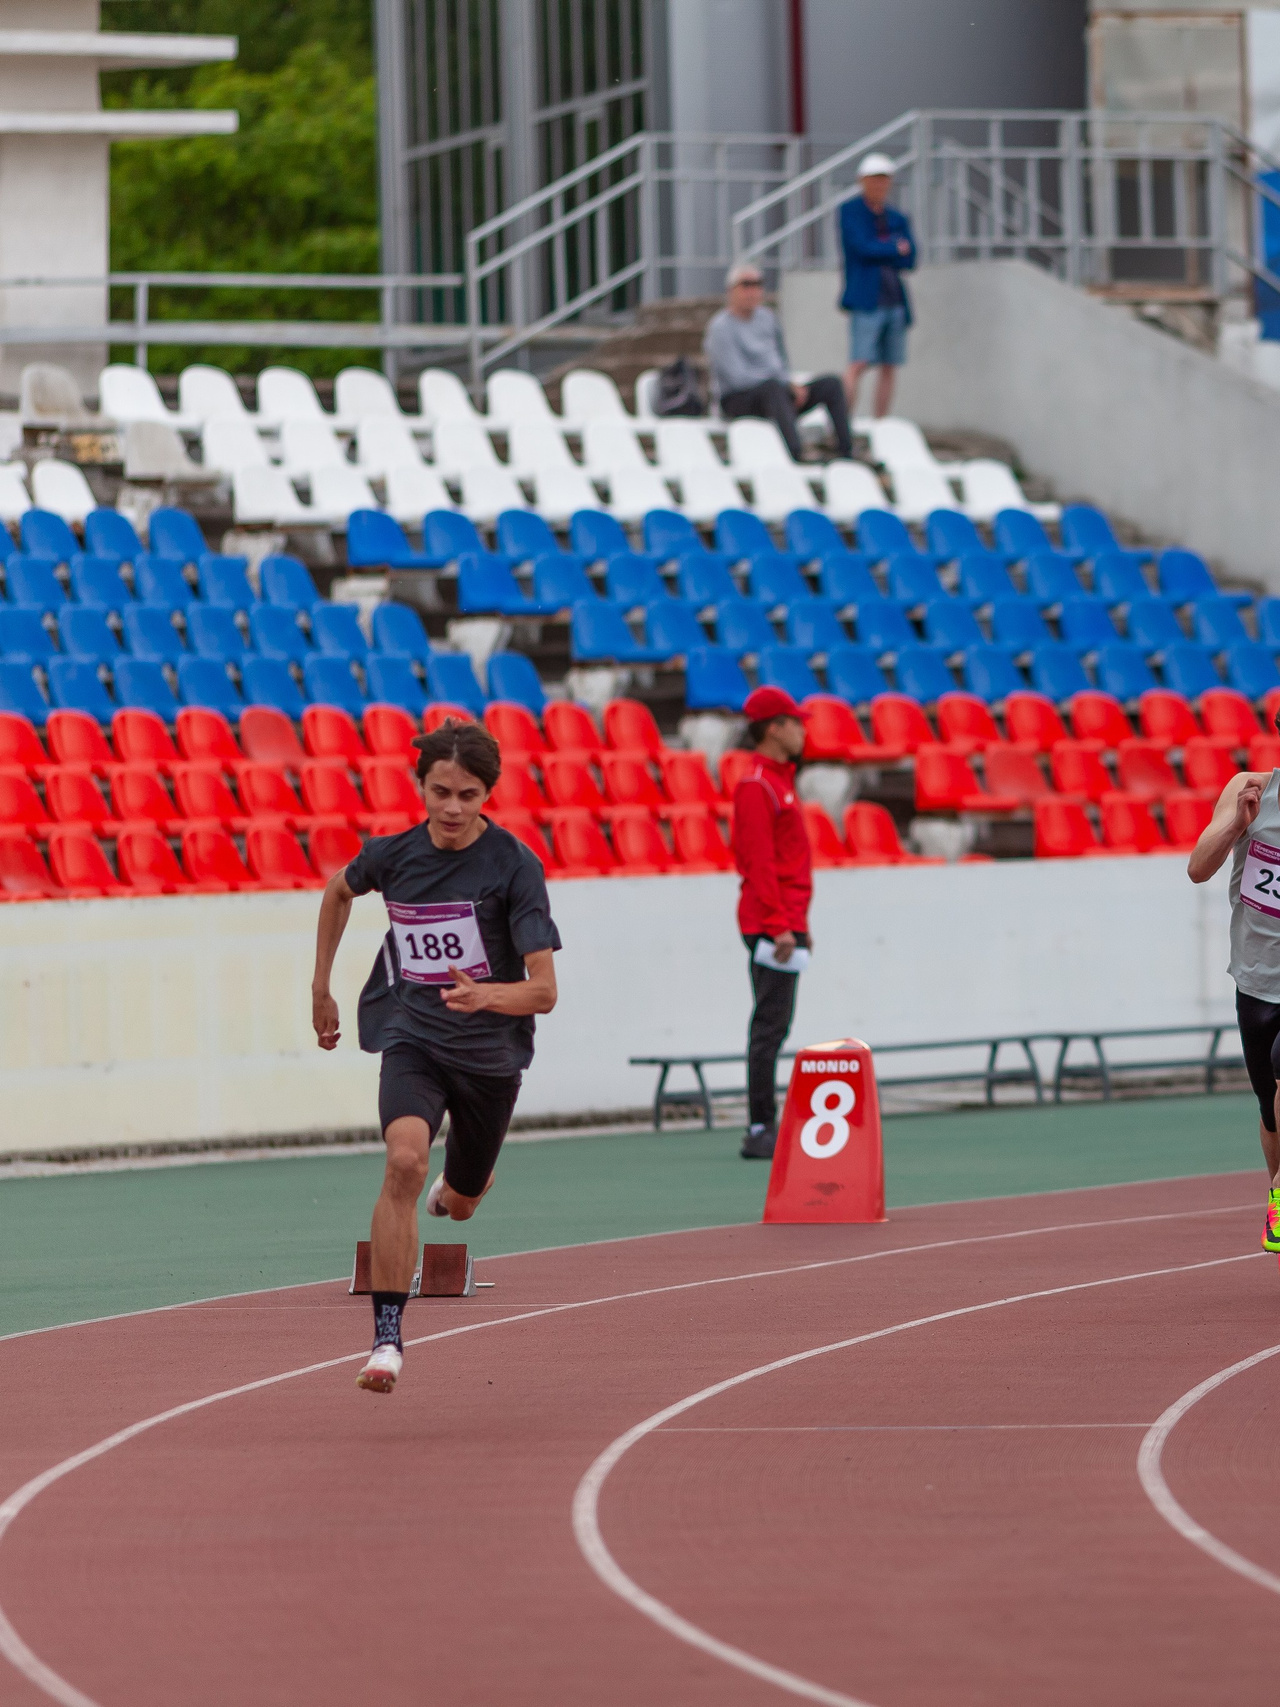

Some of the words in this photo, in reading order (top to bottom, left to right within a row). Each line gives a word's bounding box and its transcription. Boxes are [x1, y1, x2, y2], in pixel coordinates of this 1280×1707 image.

[405, 932, 464, 961] 188
[801, 1060, 860, 1073] MONDO
[800, 1079, 856, 1160] 8
[381, 1304, 399, 1316] DO
[376, 1314, 402, 1327] WHAT
[378, 1325, 398, 1335] YOU
